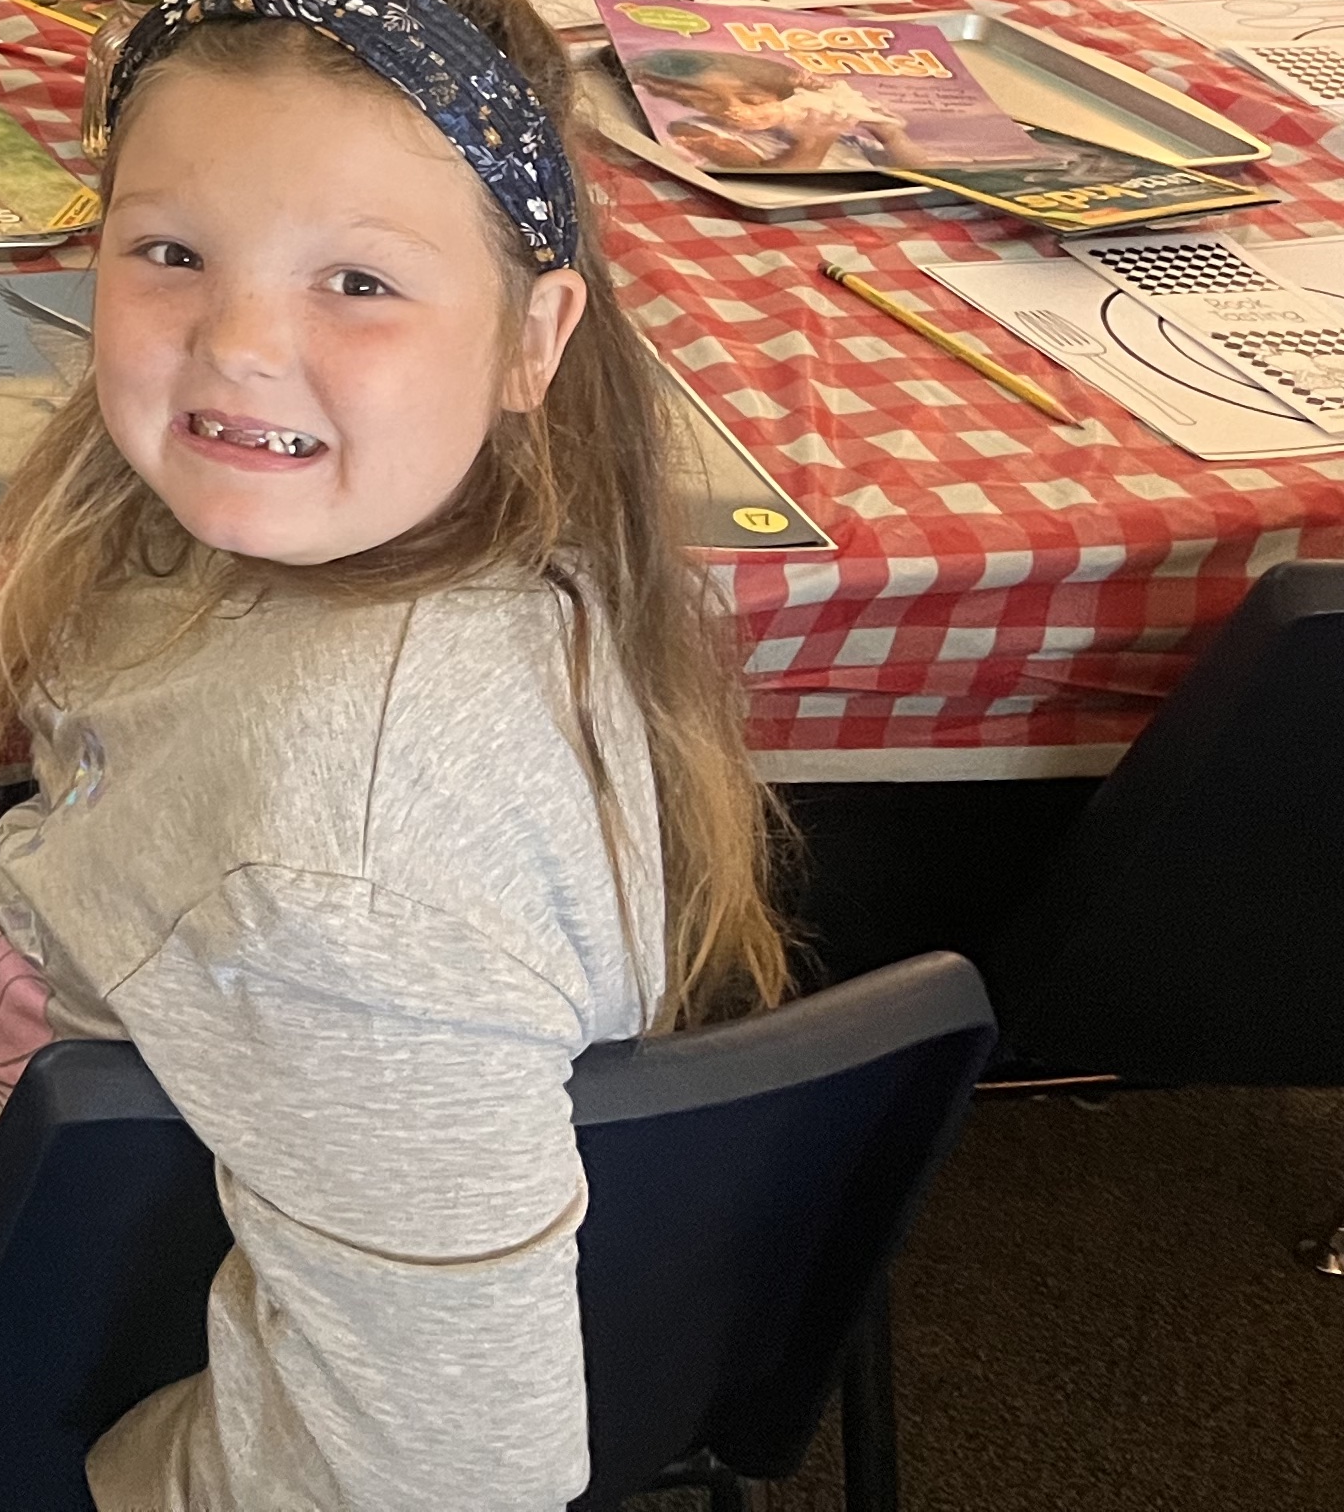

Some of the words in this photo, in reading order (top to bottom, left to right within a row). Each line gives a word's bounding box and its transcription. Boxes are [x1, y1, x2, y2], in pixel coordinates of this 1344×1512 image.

[723, 22, 895, 52] Hear
[784, 49, 953, 79] this!
[744, 512, 771, 527] 17
